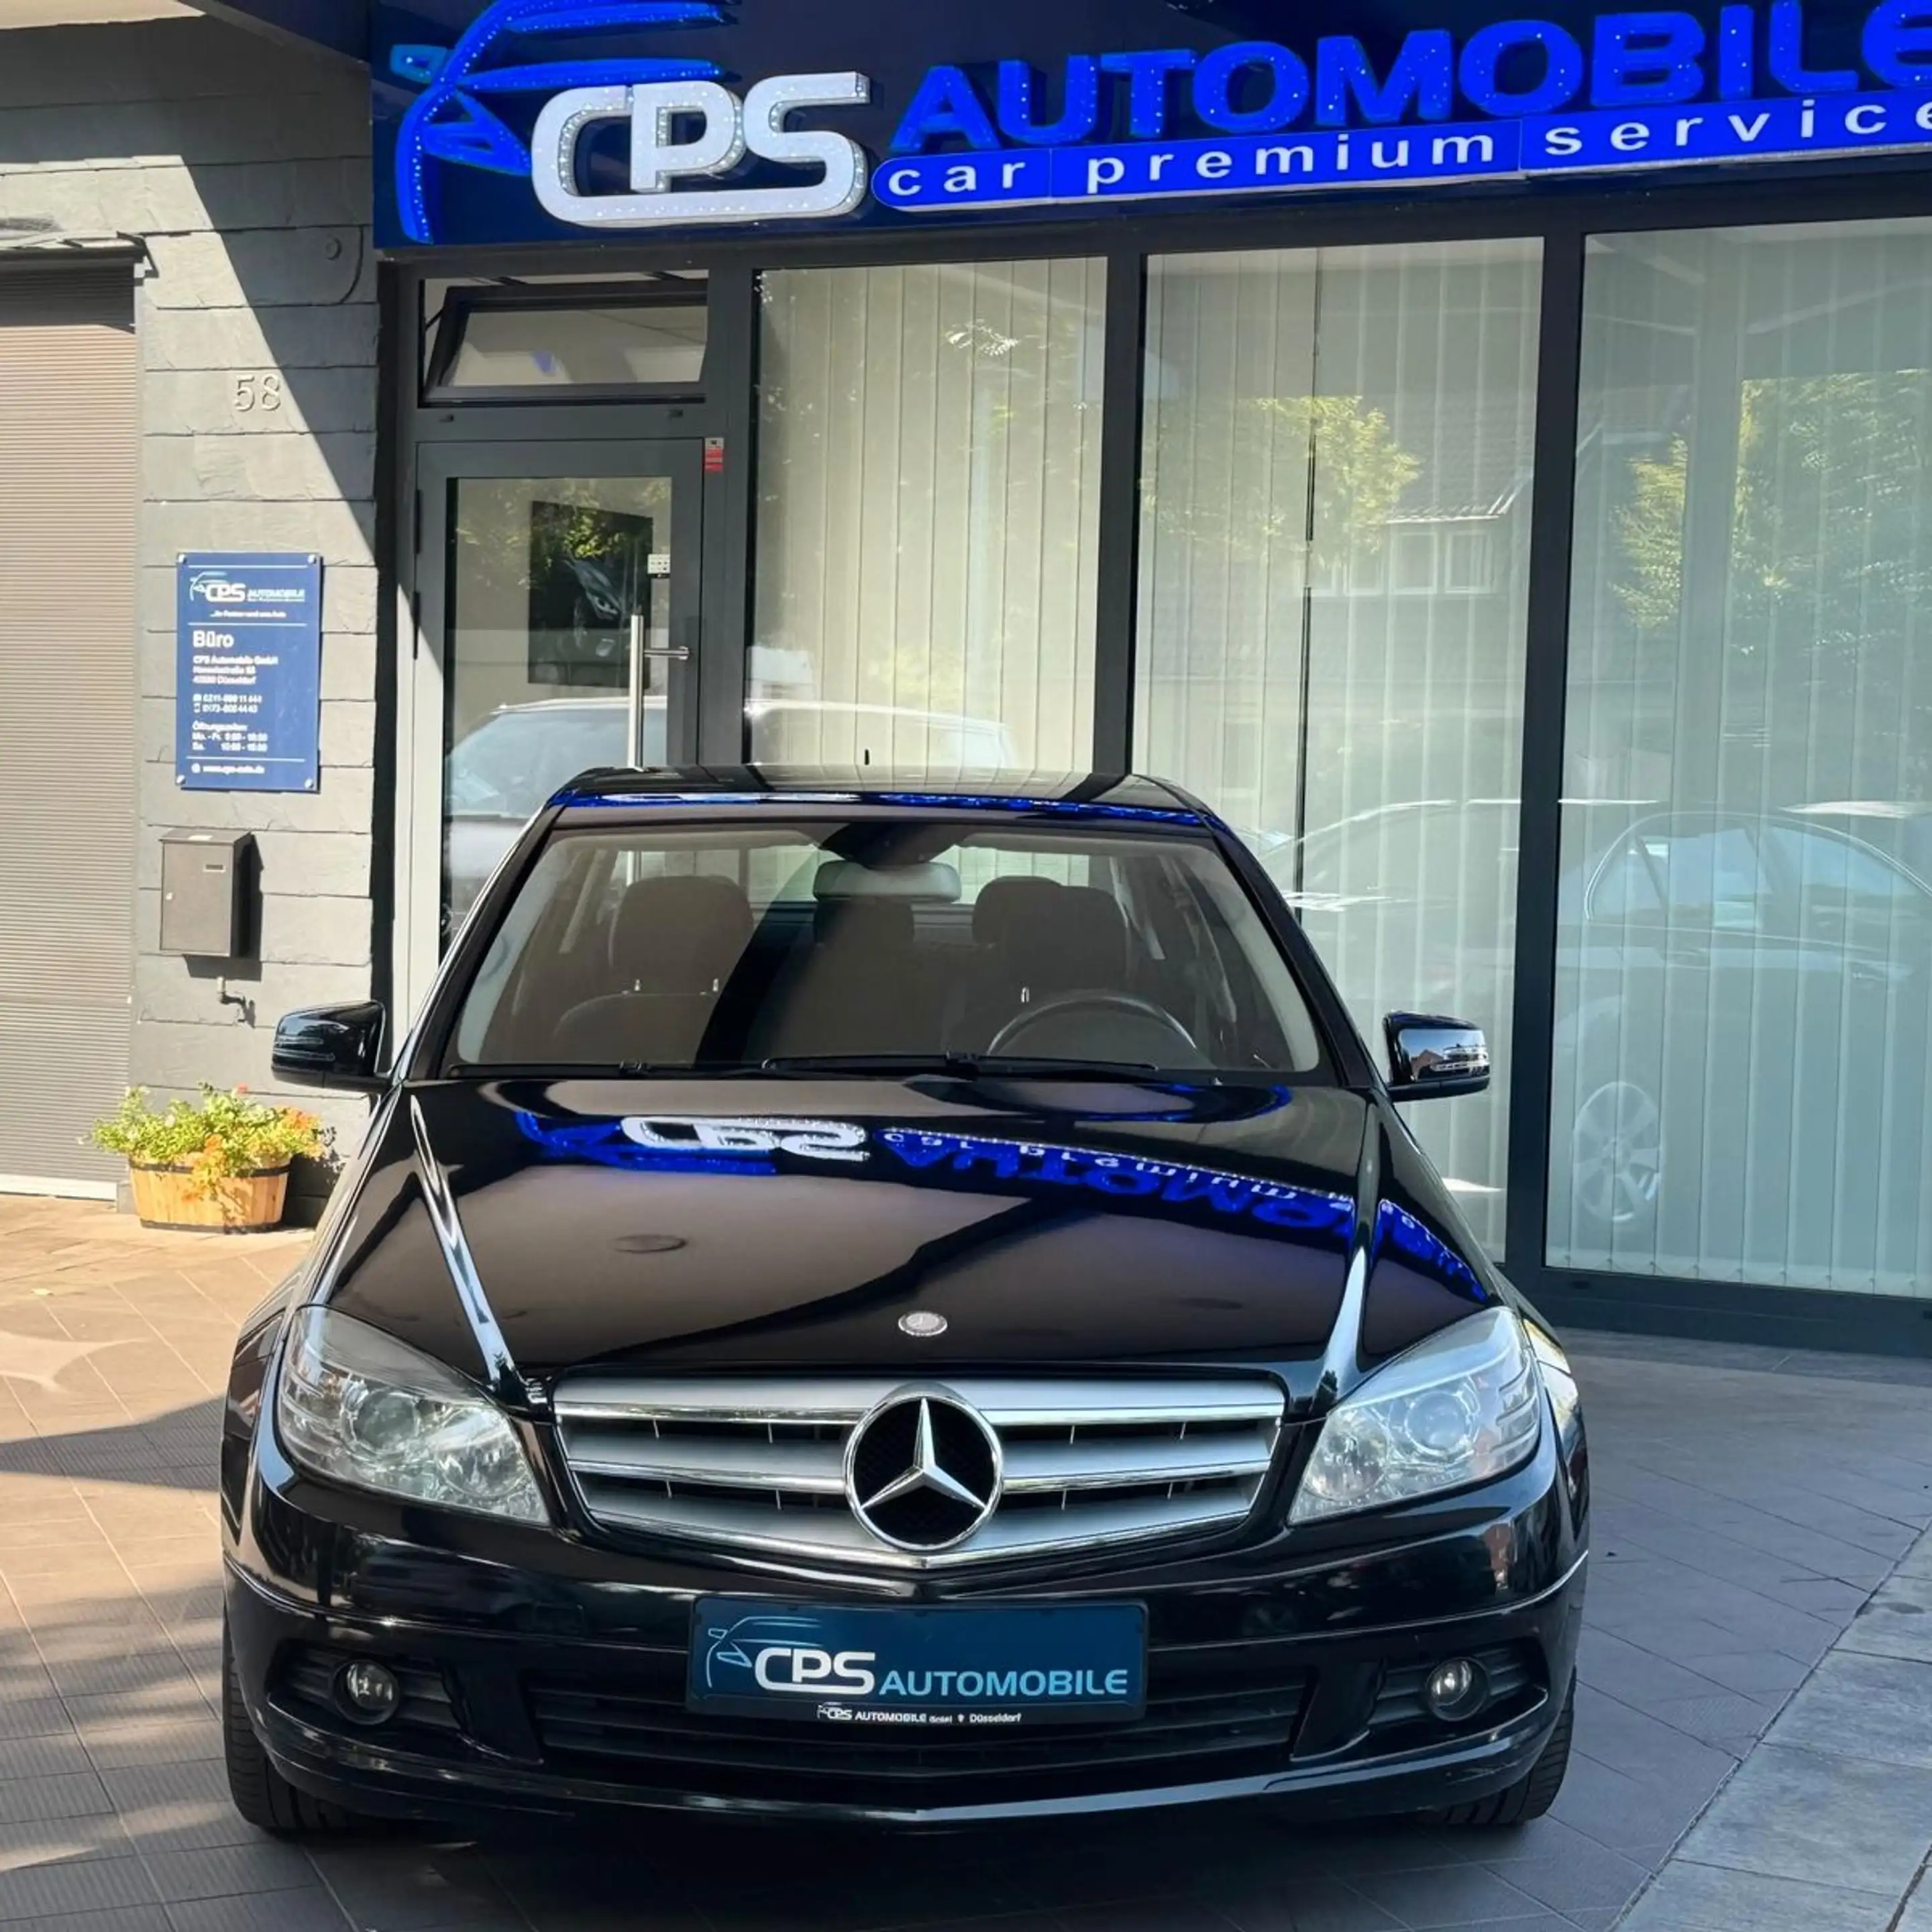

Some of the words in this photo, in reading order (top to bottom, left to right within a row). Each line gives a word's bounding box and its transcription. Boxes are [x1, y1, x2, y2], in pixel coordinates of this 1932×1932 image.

[531, 71, 871, 229] CPS
[890, 0, 1932, 152] AUTOMOBILE
[888, 159, 1026, 196] car
[1086, 133, 1494, 195] premium
[234, 374, 282, 412] 58
[205, 582, 246, 602] CPS
[193, 629, 235, 648] Büro
[754, 1647, 875, 1695] CPS
[879, 1668, 1128, 1697] AUTOMOBILE
[827, 1707, 852, 1721] CPS
[855, 1711, 926, 1723] AUTOMOBILE
[969, 1712, 1022, 1724] Düsseldorf
